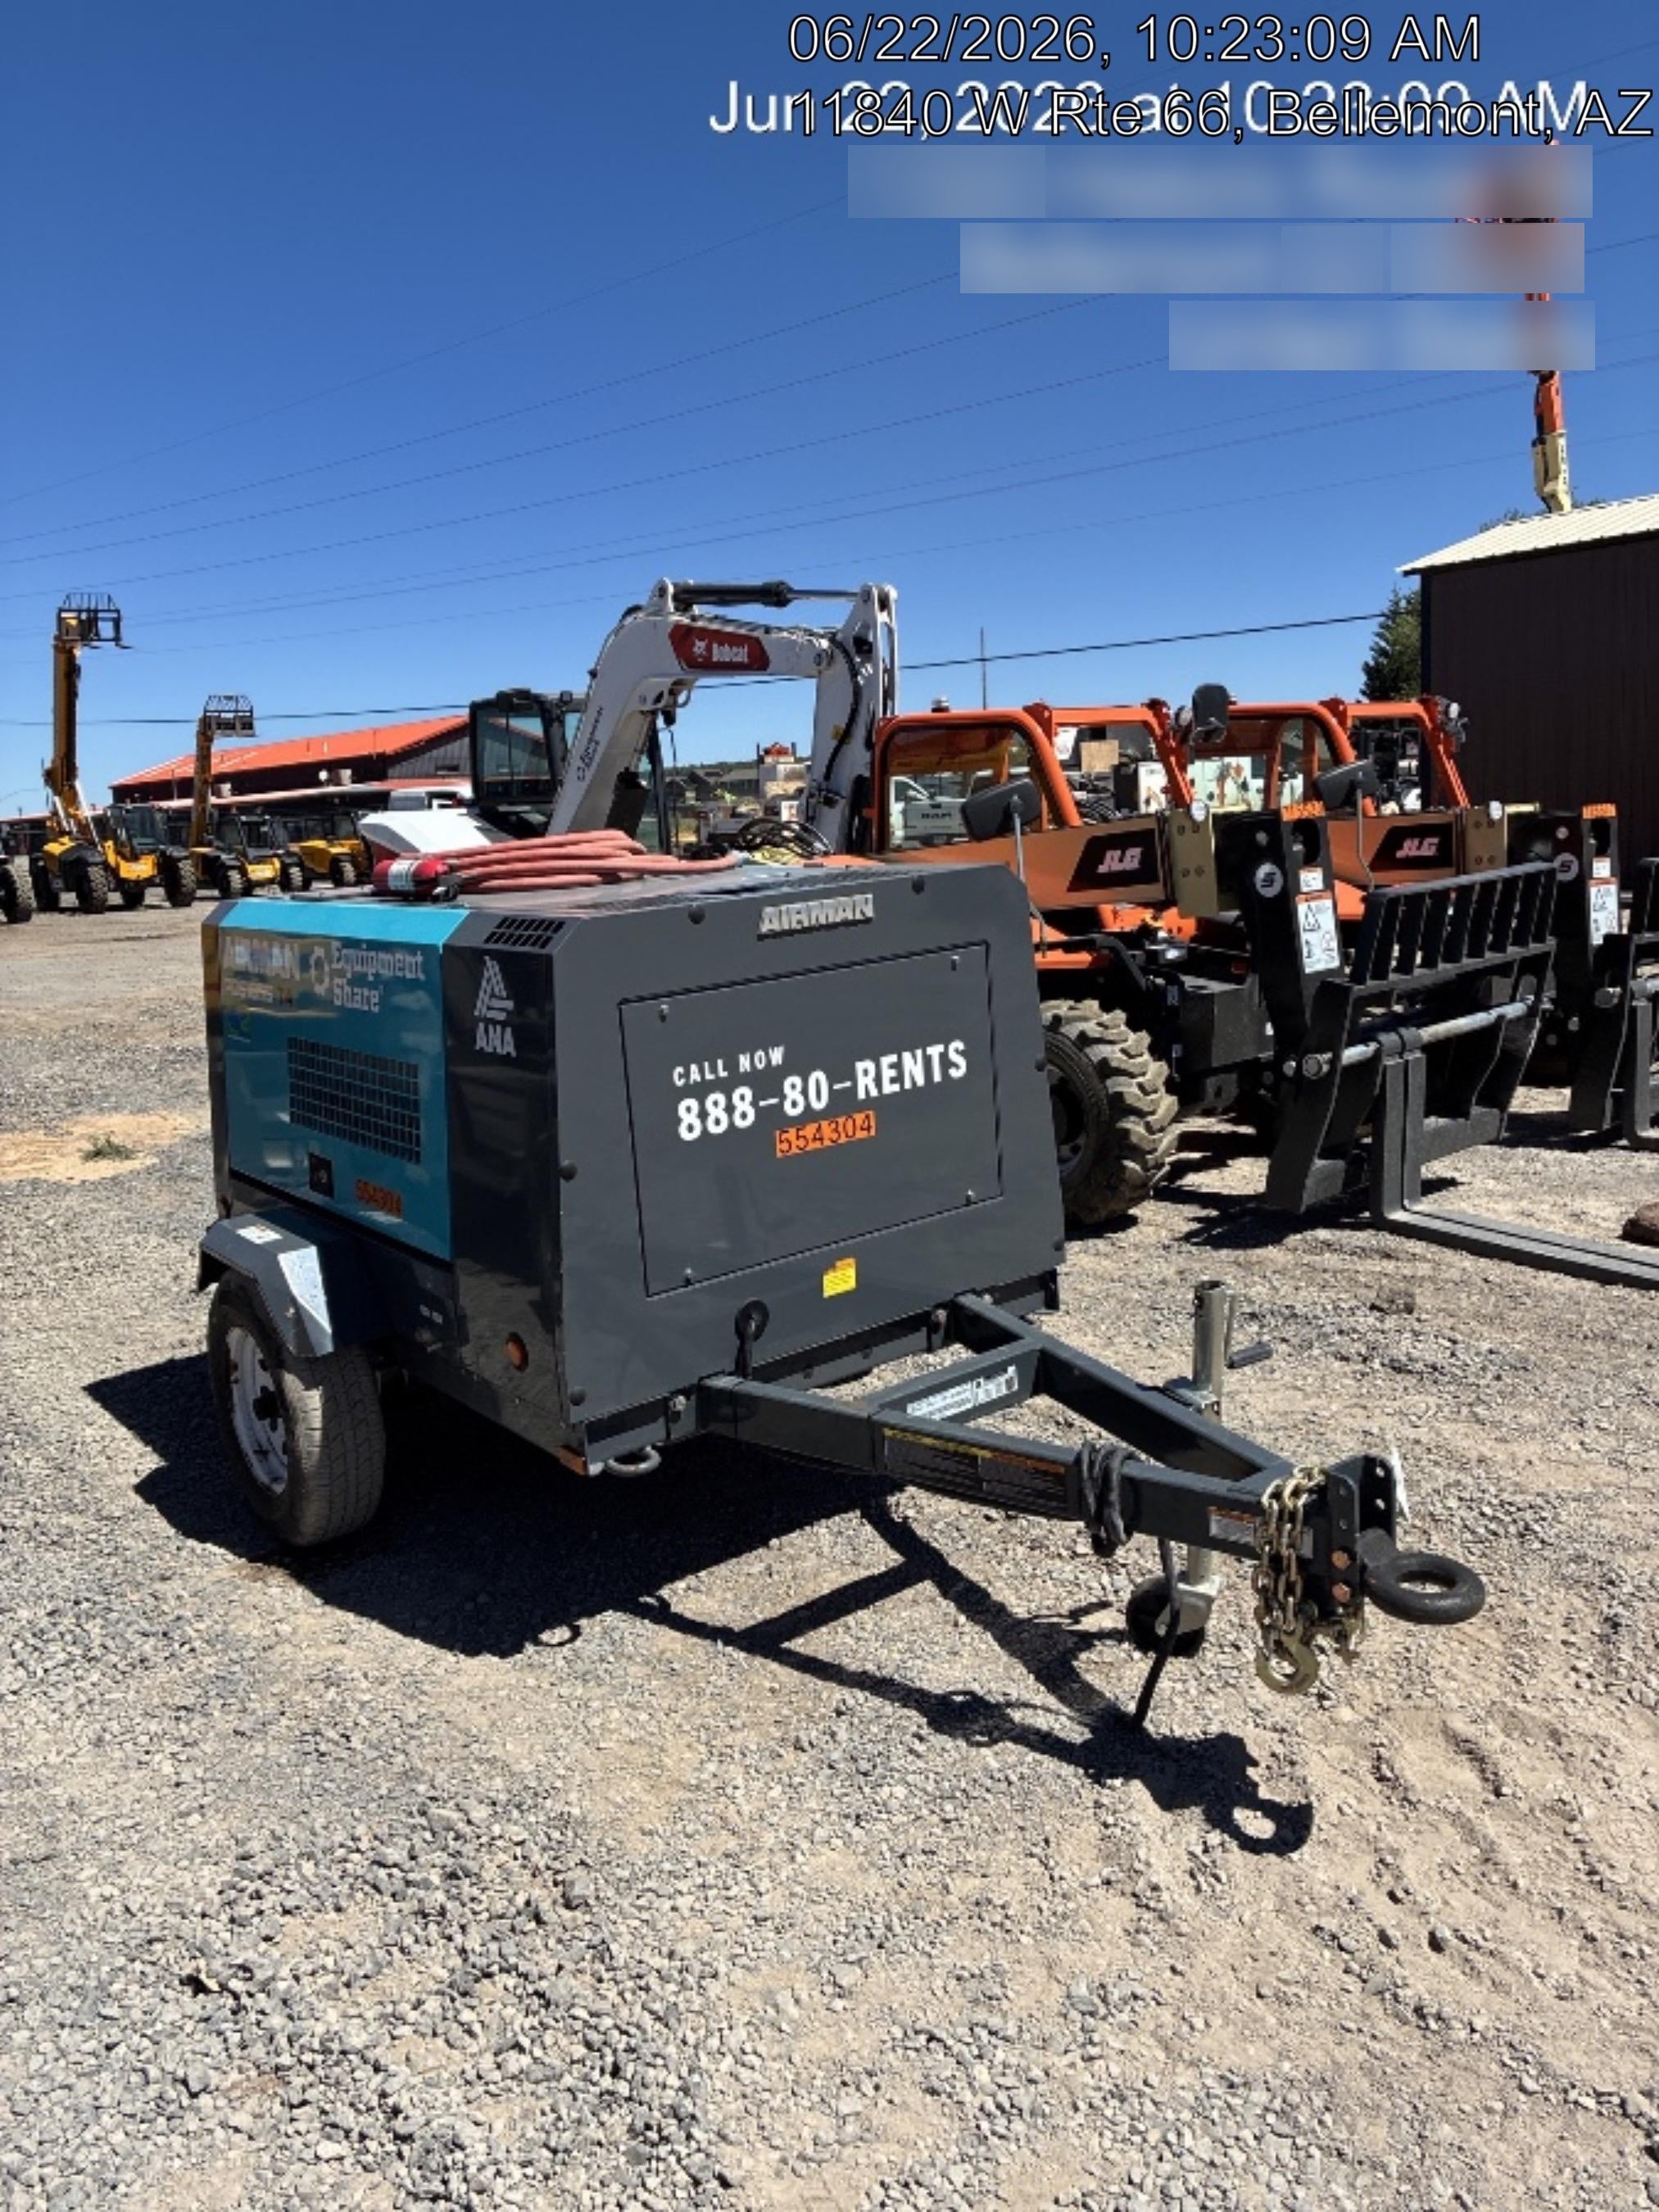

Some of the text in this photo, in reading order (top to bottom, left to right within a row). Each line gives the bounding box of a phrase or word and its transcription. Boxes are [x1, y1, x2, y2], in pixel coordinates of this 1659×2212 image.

[712, 641, 749, 664] Bobcat
[1096, 846, 1144, 874] JLG
[1395, 836, 1439, 859] JLG
[759, 893, 874, 933] AIRMAN
[330, 941, 426, 981] Equipment
[333, 978, 380, 1013] Share
[672, 1045, 786, 1087] CALL NOW
[677, 1039, 968, 1142] 888-80-RENTS
[777, 1112, 874, 1154] 554304
